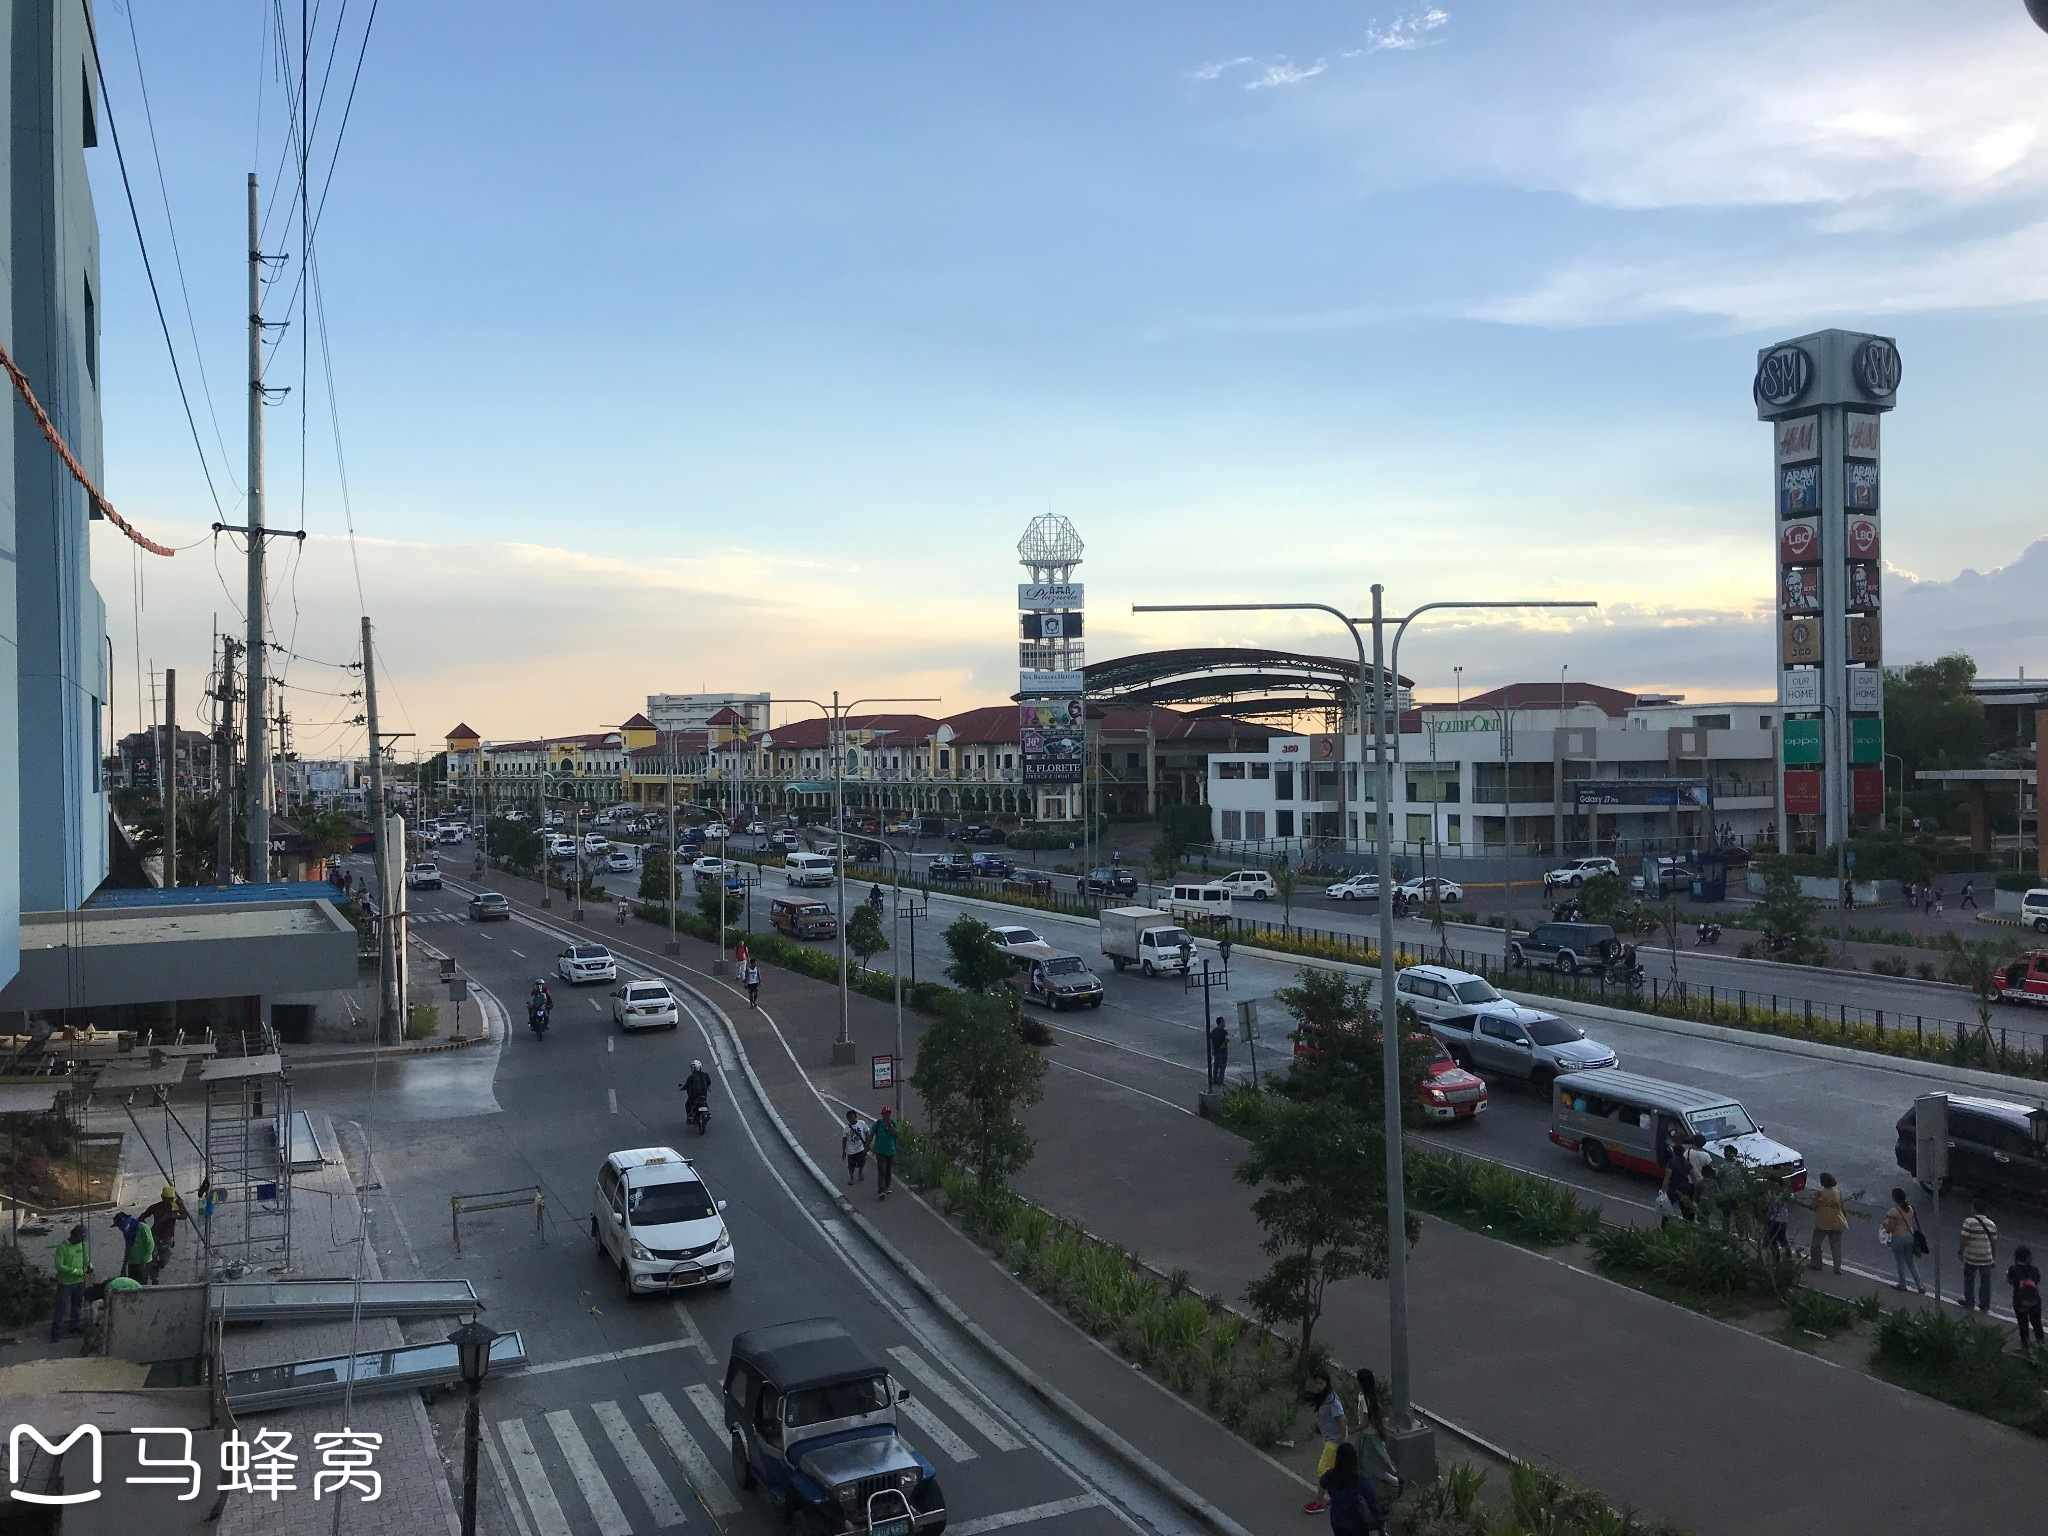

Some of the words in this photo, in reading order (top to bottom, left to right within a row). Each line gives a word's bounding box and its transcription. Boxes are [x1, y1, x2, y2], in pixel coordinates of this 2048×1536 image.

[1864, 344, 1895, 390] SM
[1760, 350, 1801, 400] SM
[1789, 532, 1809, 545] LBC
[1855, 530, 1873, 541] LBC
[1793, 678, 1810, 686] OUR
[1858, 677, 1873, 685] OUR
[1788, 690, 1814, 699] HOME
[1855, 690, 1877, 699] HOME
[1036, 763, 1081, 773] FLORETE
[1579, 795, 1602, 805] Galaxy
